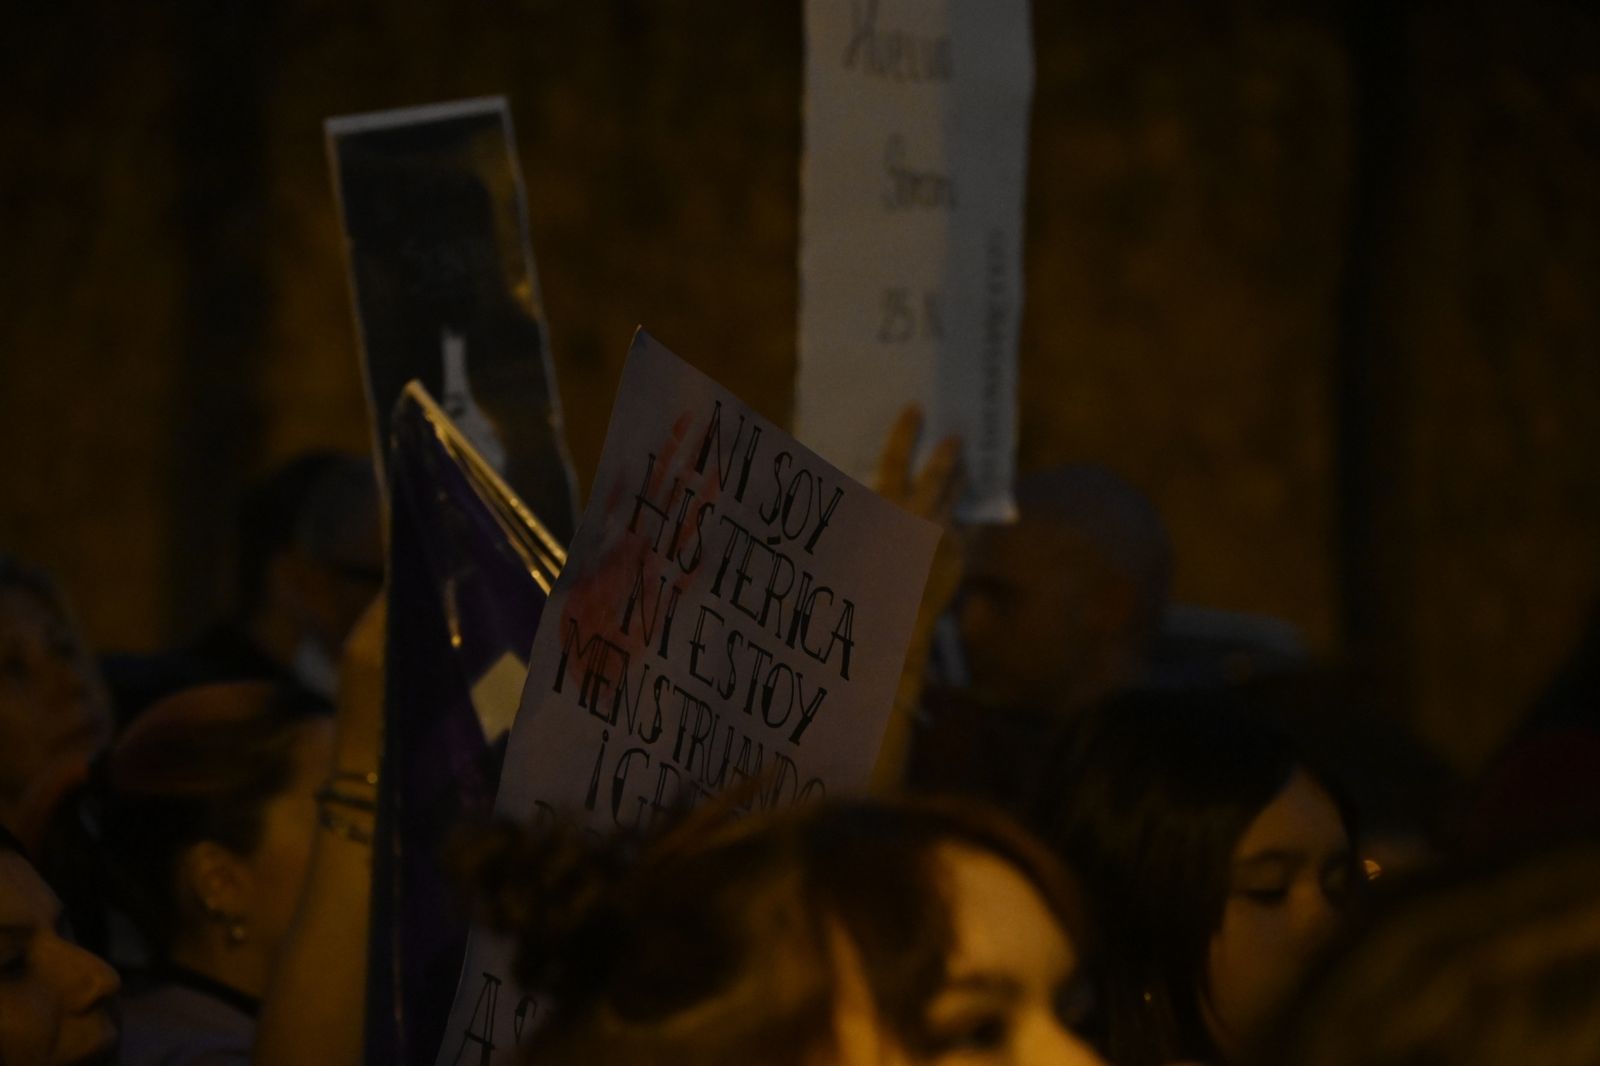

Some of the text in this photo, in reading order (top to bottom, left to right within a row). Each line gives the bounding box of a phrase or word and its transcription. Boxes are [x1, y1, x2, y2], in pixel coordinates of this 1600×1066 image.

[628, 452, 855, 681] HISTÉRICA
[694, 401, 844, 555] NI SOY
[620, 561, 828, 746] NI ESTOY
